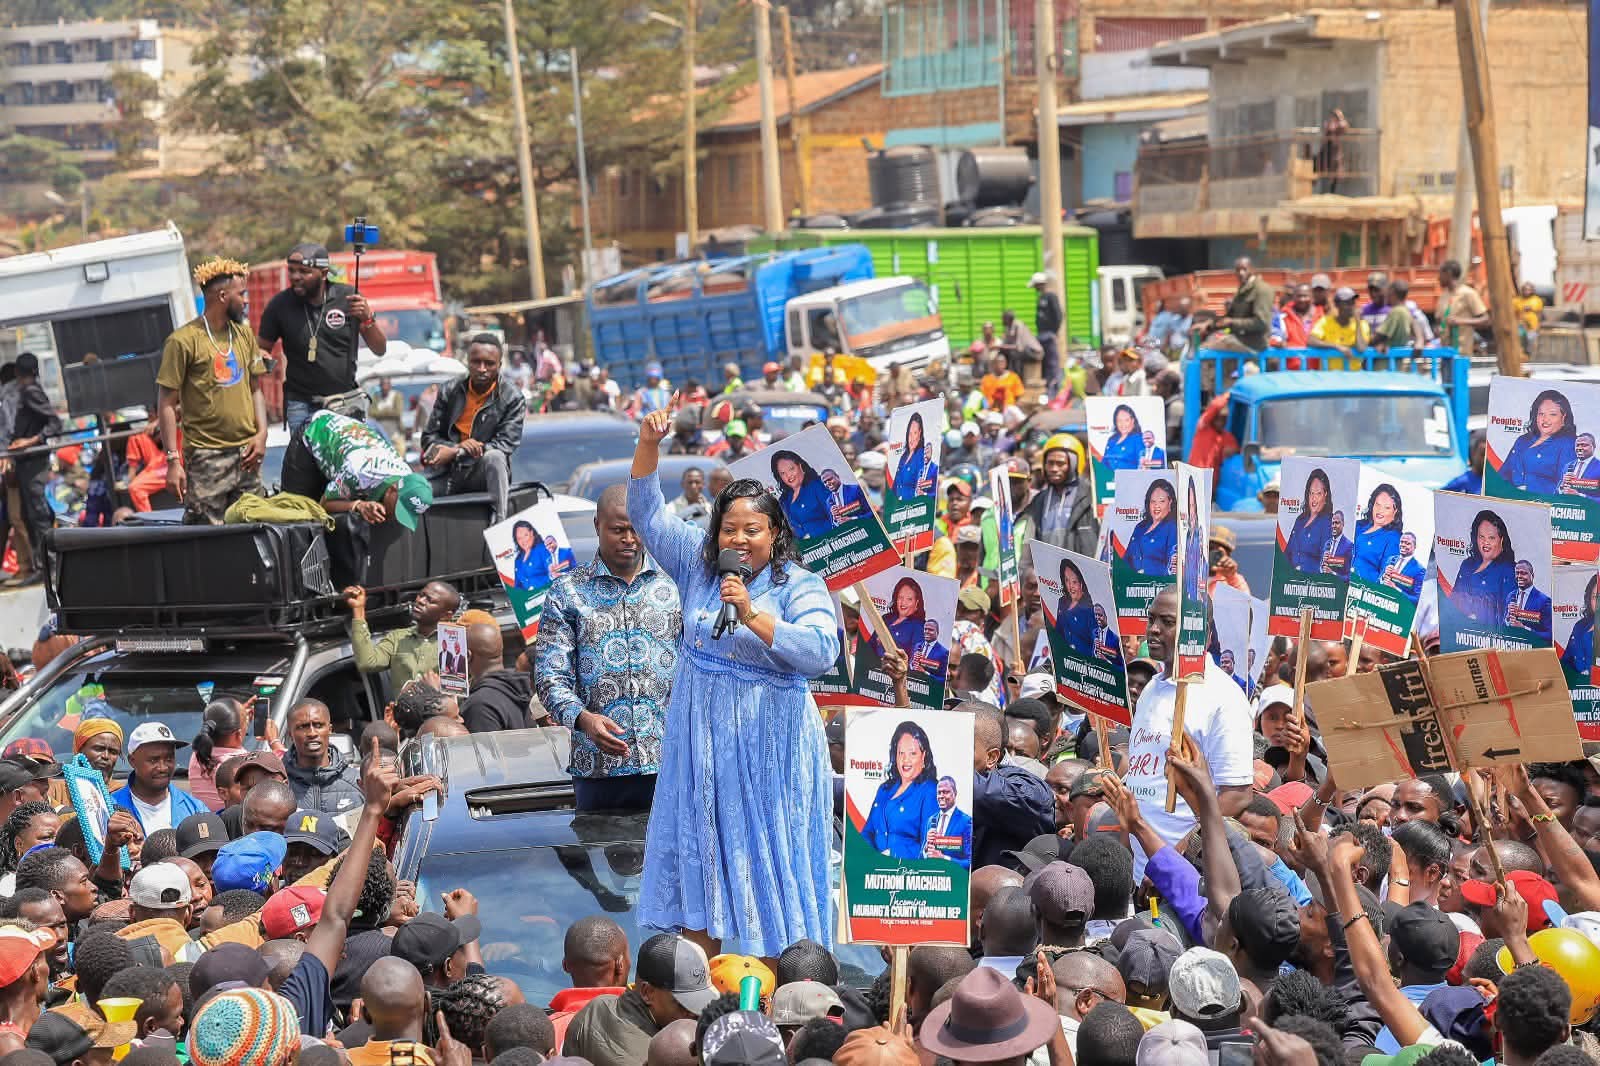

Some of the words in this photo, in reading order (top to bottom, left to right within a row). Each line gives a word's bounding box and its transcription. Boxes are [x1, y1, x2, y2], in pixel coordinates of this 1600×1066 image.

[1491, 416, 1522, 427] People's
[1551, 506, 1586, 521] ACHARIA
[1580, 532, 1594, 542] REP
[1553, 604, 1578, 613] eople's
[1569, 689, 1600, 700] MUTHON
[850, 759, 882, 771] People's
[300, 815, 318, 833] N
[865, 874, 904, 889] MUTHONI
[905, 876, 952, 891] MACHARIA
[889, 890, 927, 907] Incoming
[853, 904, 890, 917] MURANG'A
[890, 905, 917, 918] COUNTY
[917, 906, 946, 918] WOMAN
[947, 906, 961, 919] REP
